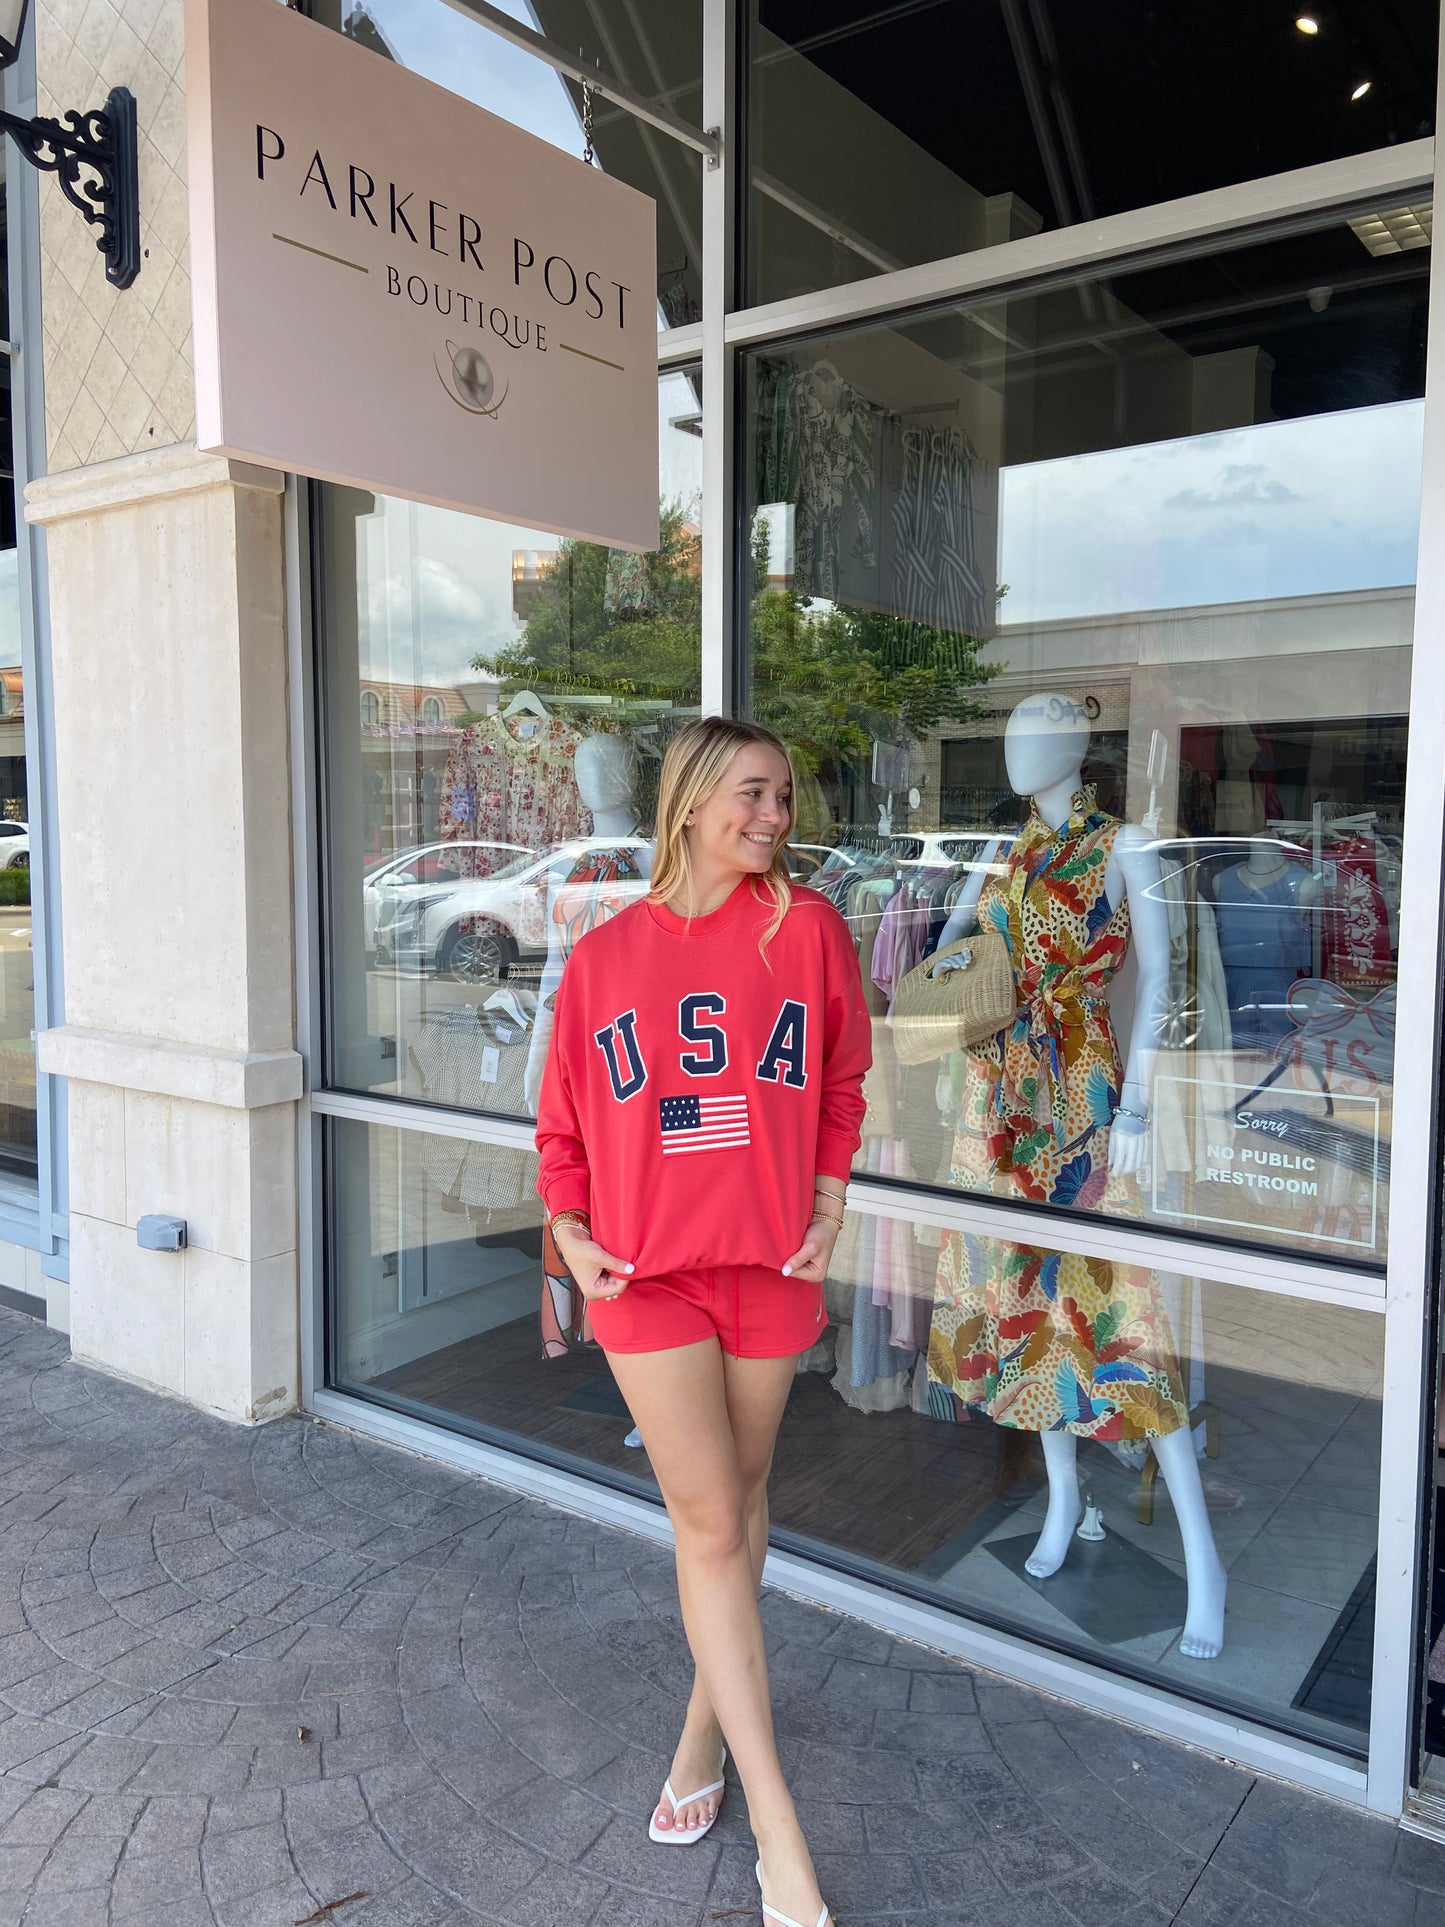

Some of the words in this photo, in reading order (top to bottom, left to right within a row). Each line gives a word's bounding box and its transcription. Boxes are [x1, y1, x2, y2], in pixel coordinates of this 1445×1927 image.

[256, 124, 485, 271] PARKER
[513, 238, 631, 329] POST
[386, 265, 547, 352] BOUTIQUE
[594, 991, 808, 1104] USA
[1233, 1111, 1289, 1138] Sorry
[1206, 1144, 1235, 1161] NO
[1241, 1149, 1316, 1172] PUBLIC
[1206, 1167, 1318, 1196] RESTROOM
